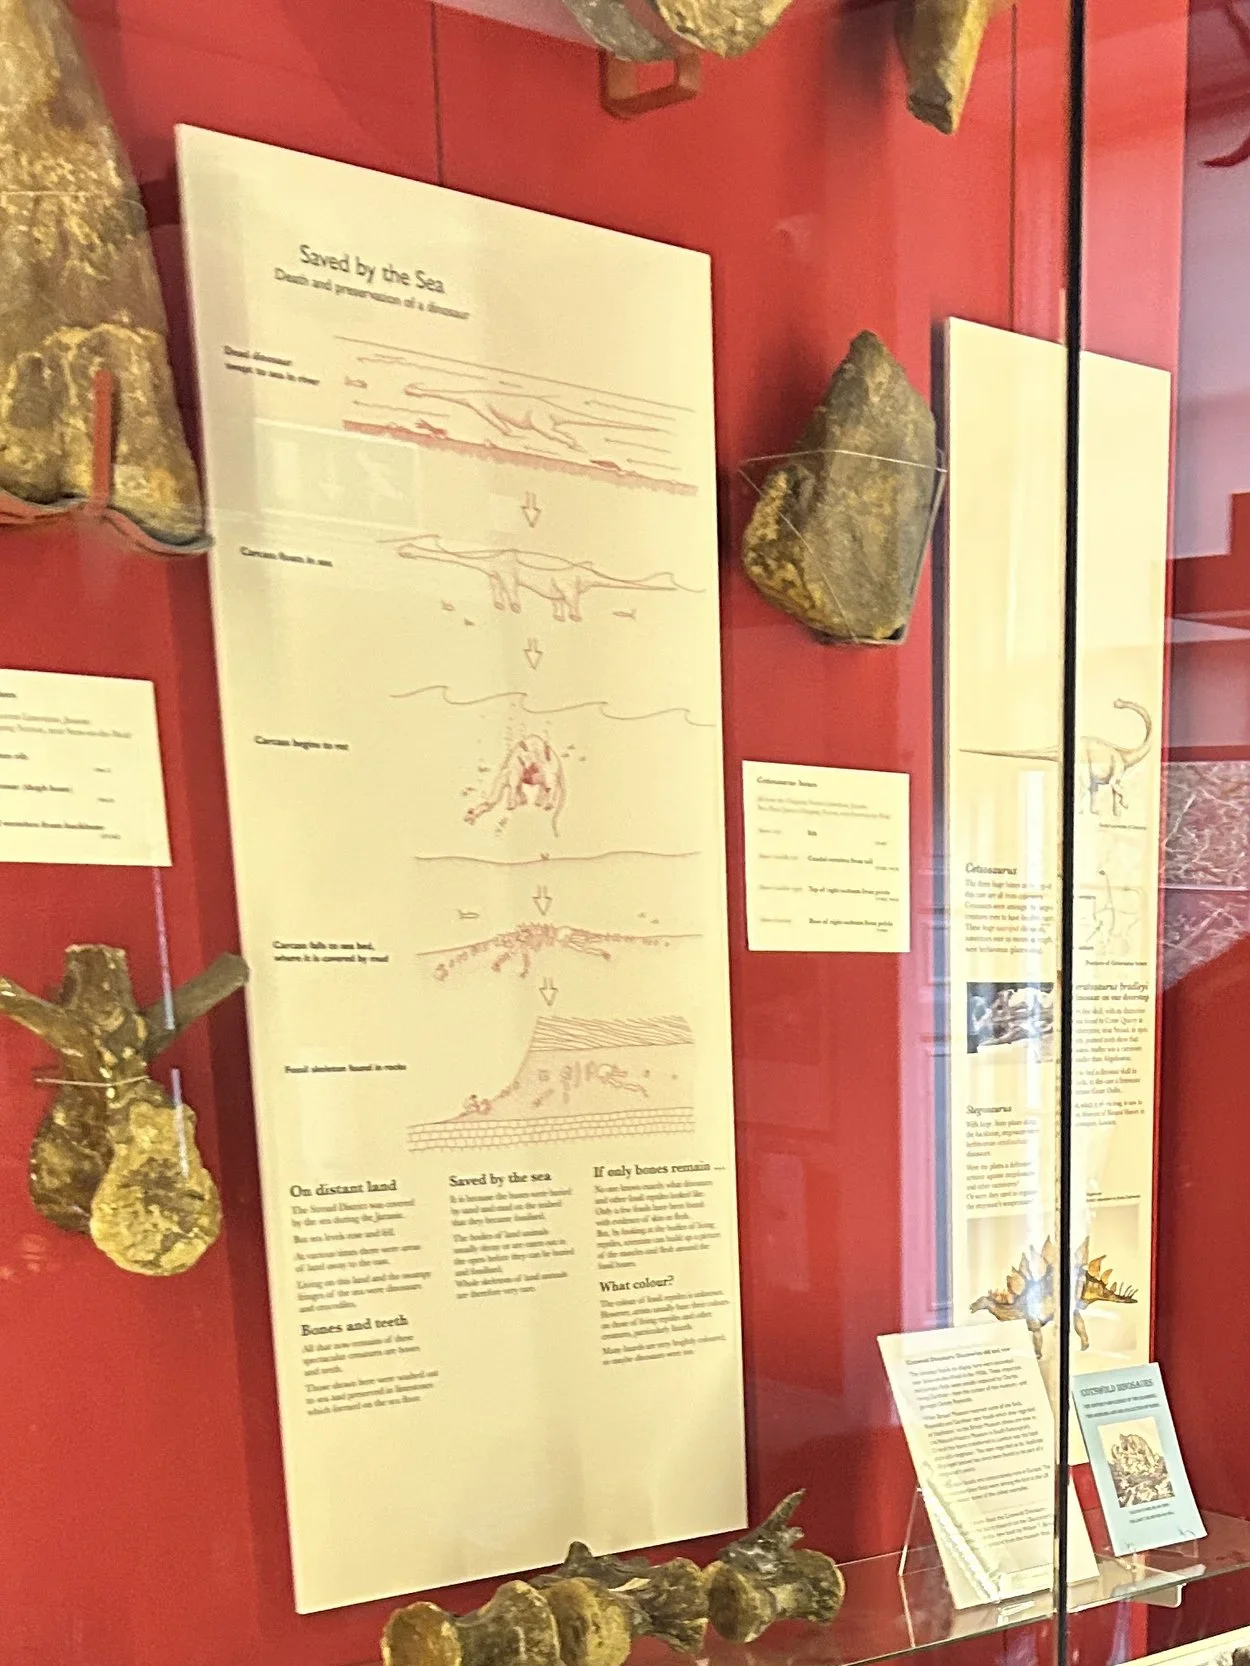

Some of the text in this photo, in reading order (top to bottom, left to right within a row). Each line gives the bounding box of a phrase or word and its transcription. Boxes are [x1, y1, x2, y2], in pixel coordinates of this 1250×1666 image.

[300, 244, 446, 294] Saved by the Sea
[449, 1172, 553, 1188] Saved by the sea
[607, 1165, 632, 1179] only
[634, 1164, 669, 1176] bones
[671, 1163, 711, 1173] remain
[289, 1179, 398, 1198] On distant land
[599, 1275, 674, 1293] What colour?
[300, 1314, 409, 1337] Bones and teeth
